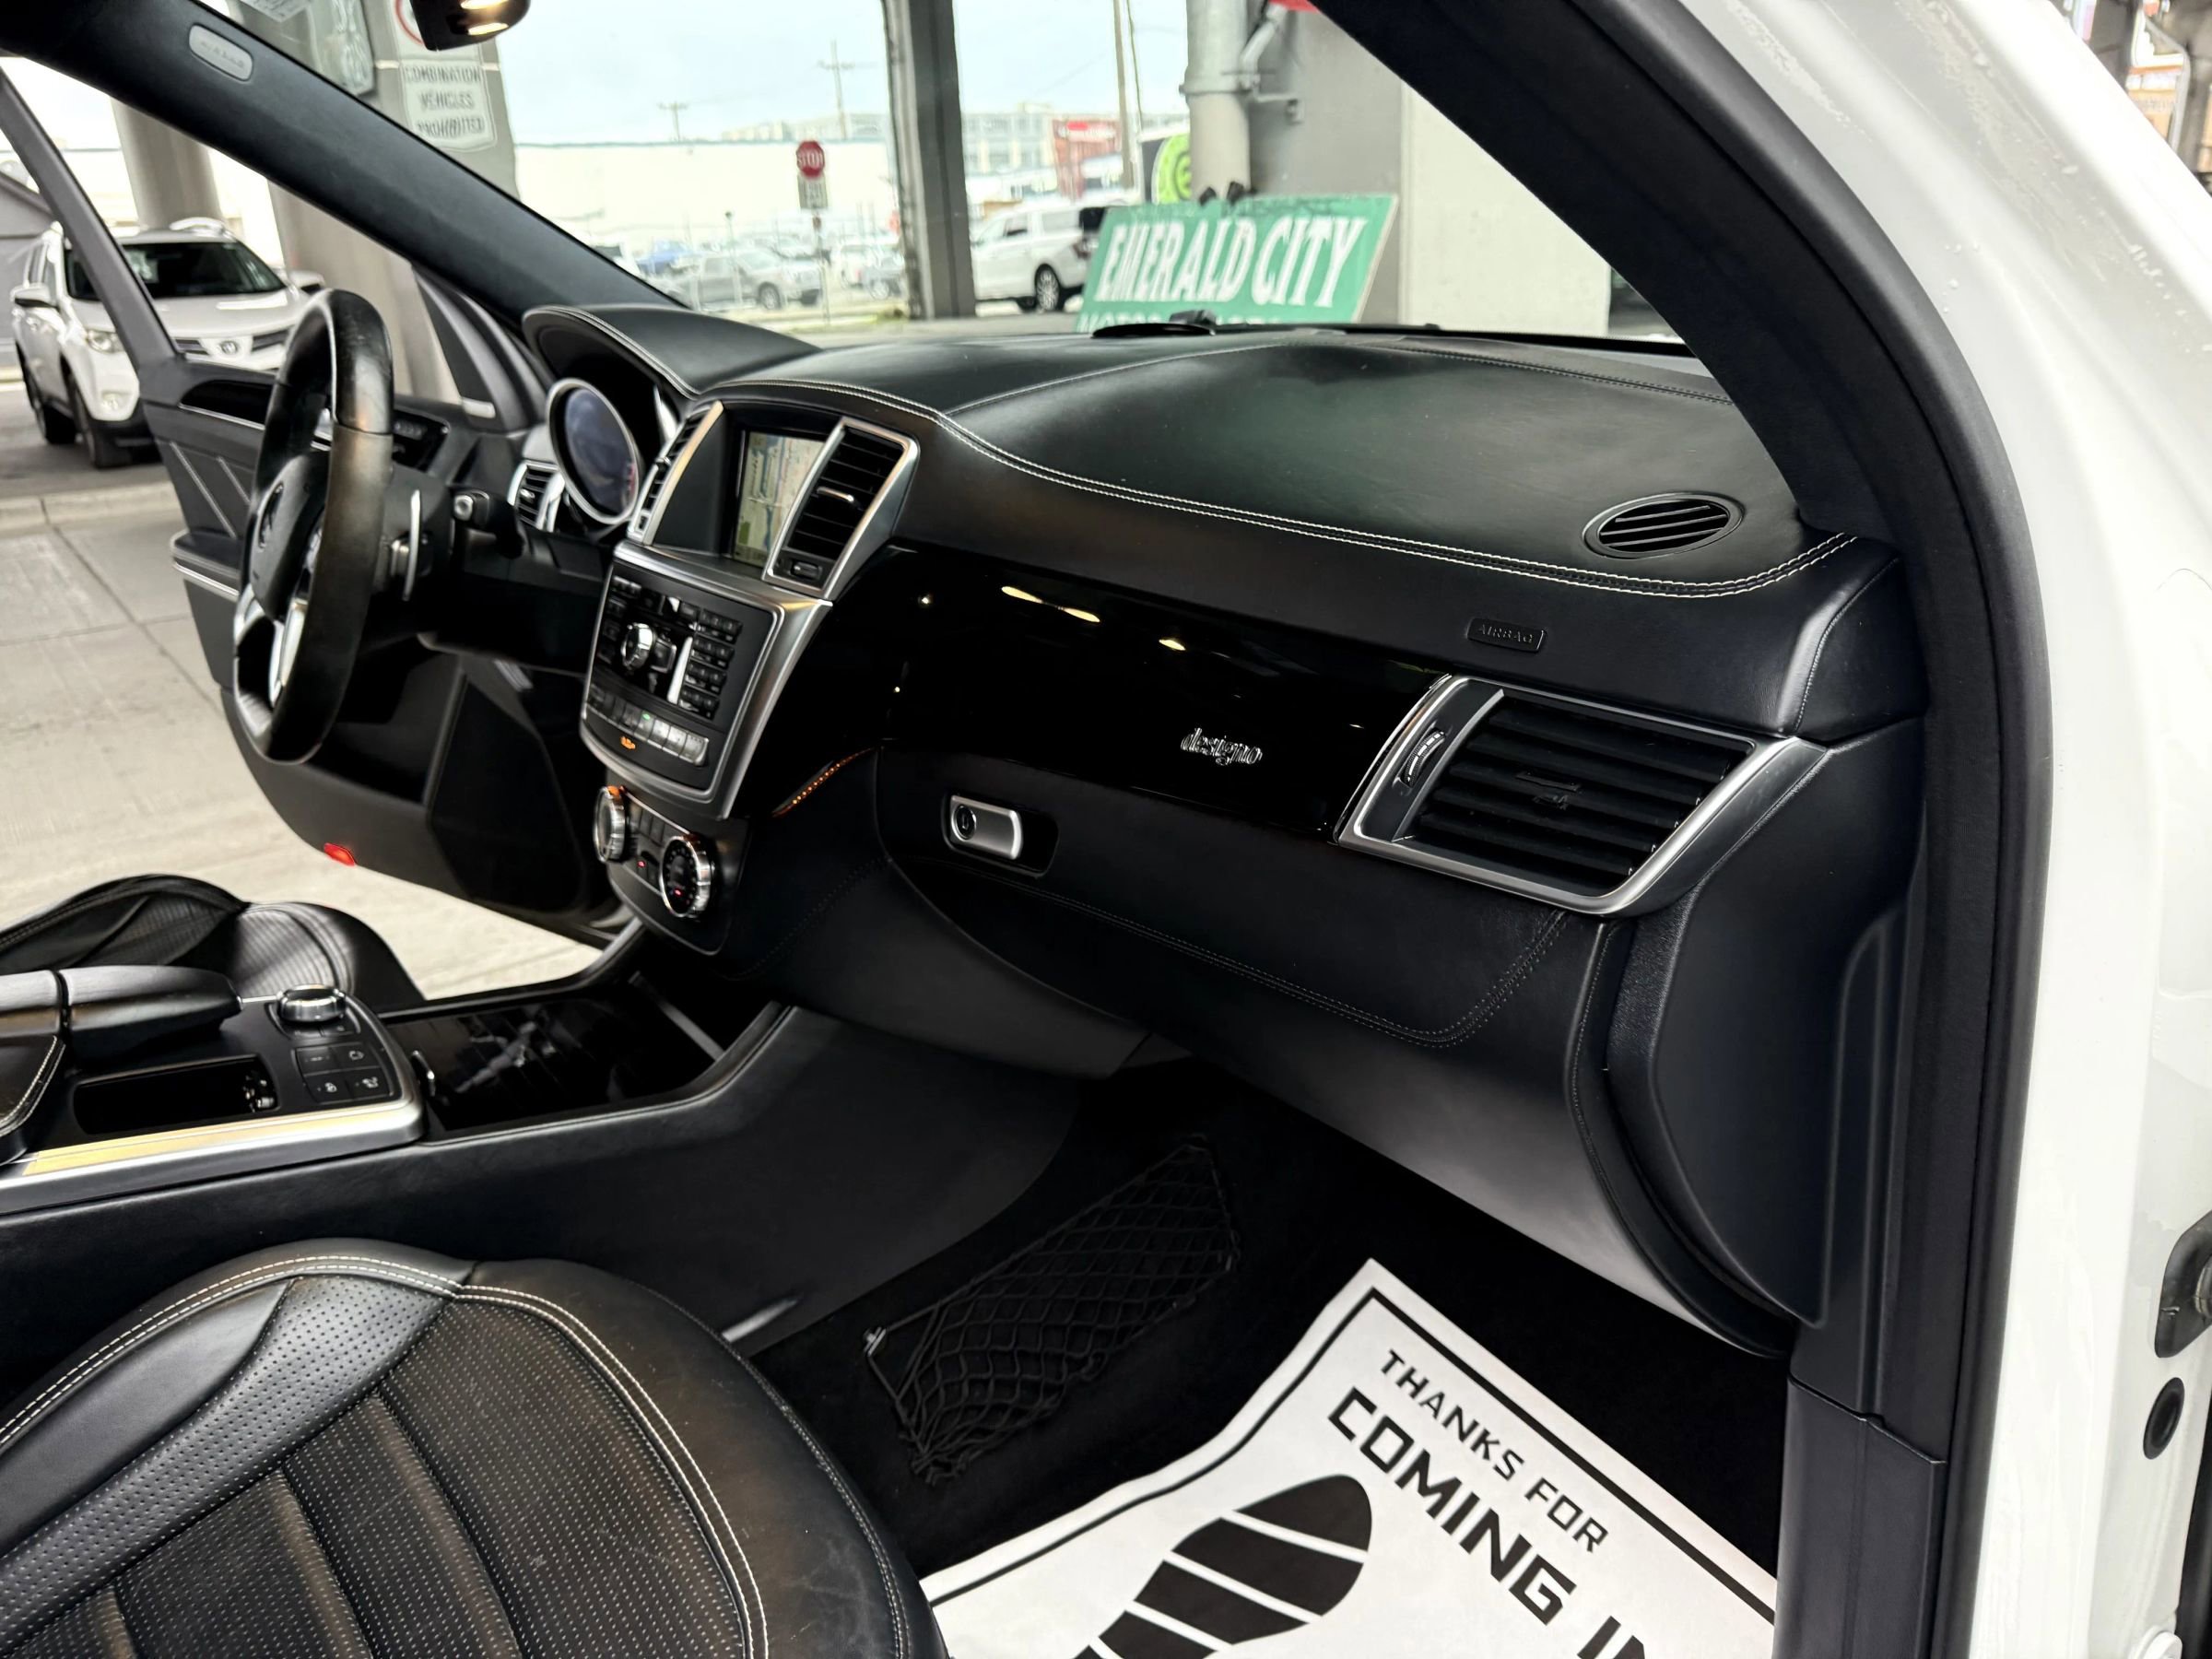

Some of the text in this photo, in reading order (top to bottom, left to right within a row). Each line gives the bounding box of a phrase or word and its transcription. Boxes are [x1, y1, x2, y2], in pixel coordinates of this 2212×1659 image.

[405, 65, 480, 82] COMBINATION
[1094, 216, 1369, 308] EMERALD CITY
[1181, 727, 1263, 766] designo
[1381, 1348, 1609, 1553] THANKS FOR
[1327, 1386, 1577, 1626] COMING
